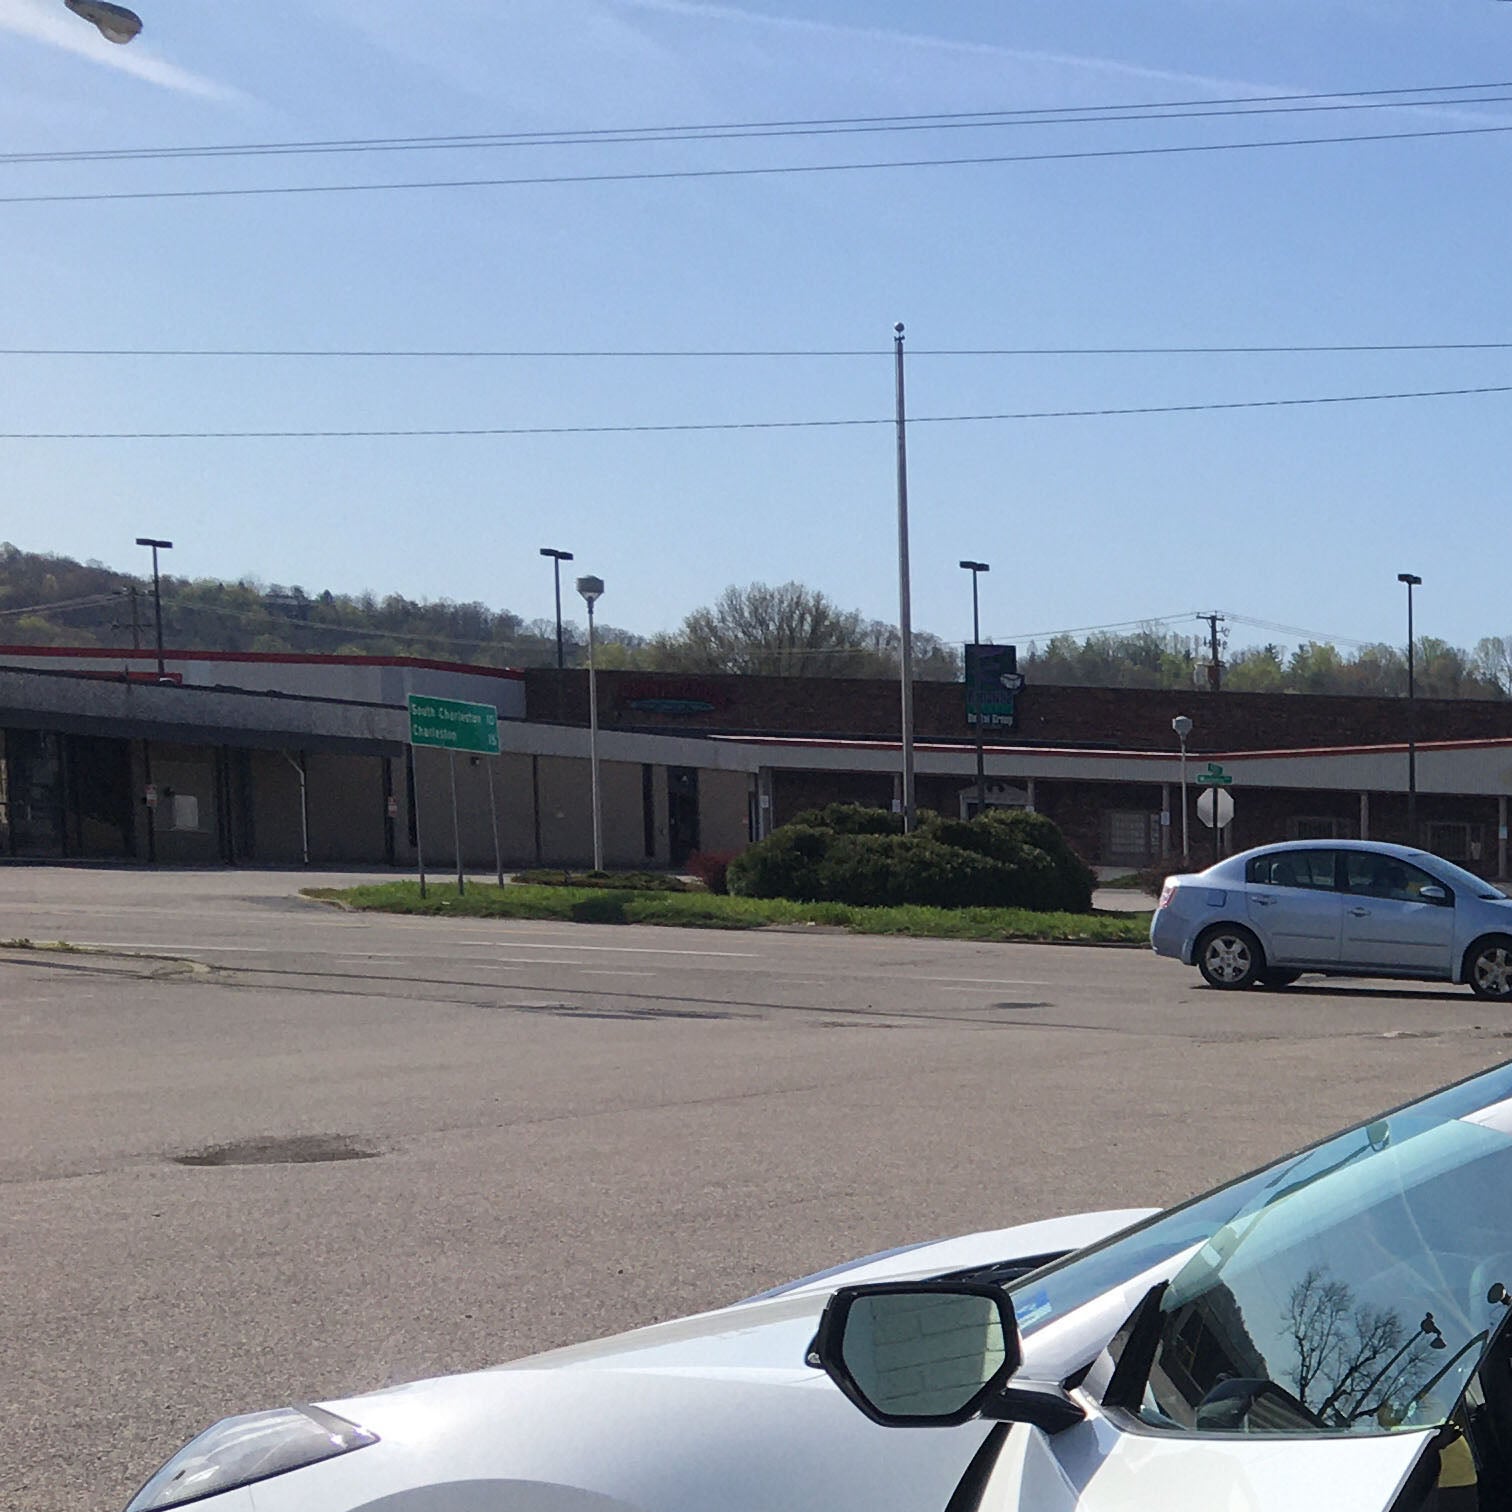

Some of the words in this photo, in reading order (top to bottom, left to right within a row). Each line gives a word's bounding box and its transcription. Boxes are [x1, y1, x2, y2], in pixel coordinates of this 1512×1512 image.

[411, 703, 436, 717] South
[439, 707, 481, 723] Charleston
[413, 723, 457, 741] Charleston
